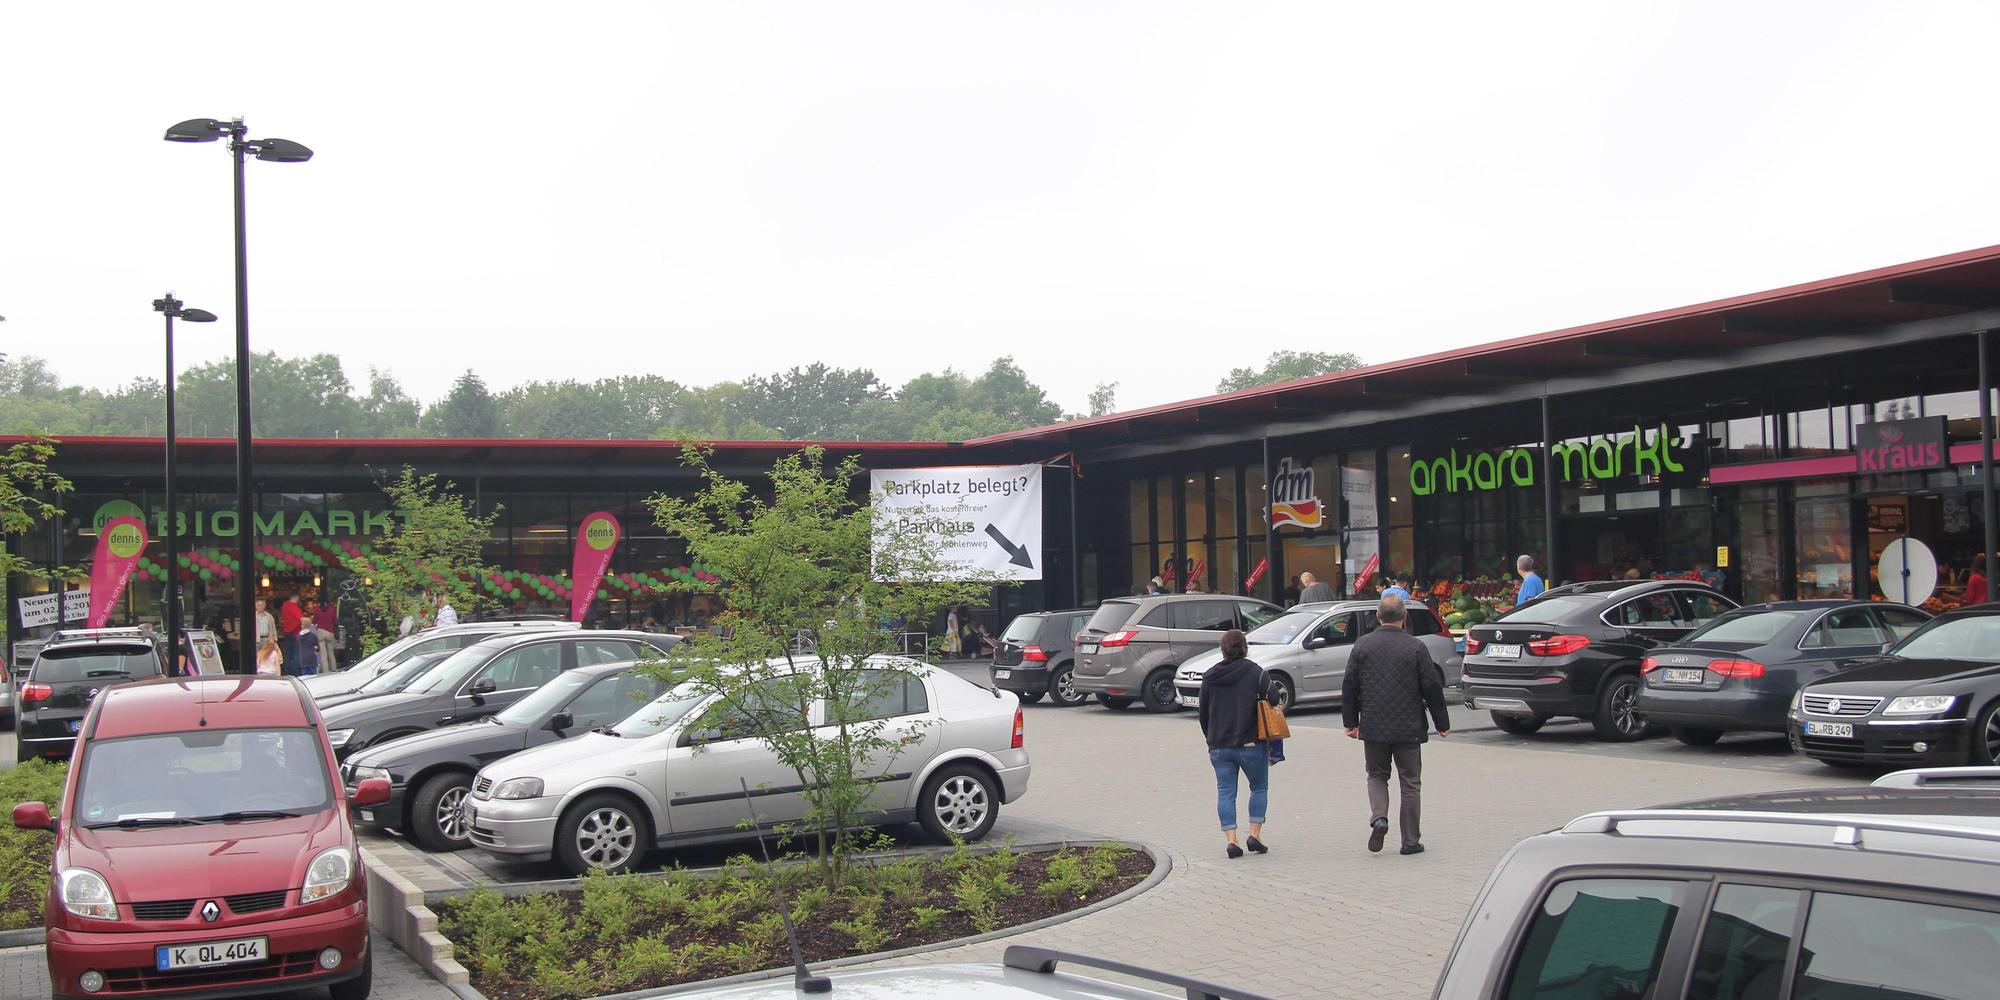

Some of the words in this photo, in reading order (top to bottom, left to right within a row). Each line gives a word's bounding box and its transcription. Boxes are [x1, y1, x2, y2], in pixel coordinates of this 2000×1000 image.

[1409, 447, 1534, 496] ankara
[1551, 421, 1684, 481] markt
[886, 479, 960, 498] Parkplatz
[968, 477, 1028, 496] belegt?
[1273, 458, 1314, 503] dm
[926, 504, 939, 513] das
[899, 519, 975, 534] Parkhaus
[1689, 671, 1701, 680] 154
[1808, 724, 1818, 733] GL
[1822, 725, 1834, 735] RB
[1835, 726, 1851, 736] 249
[175, 949, 186, 965] K
[199, 946, 222, 962] QL
[226, 942, 258, 960] 404
